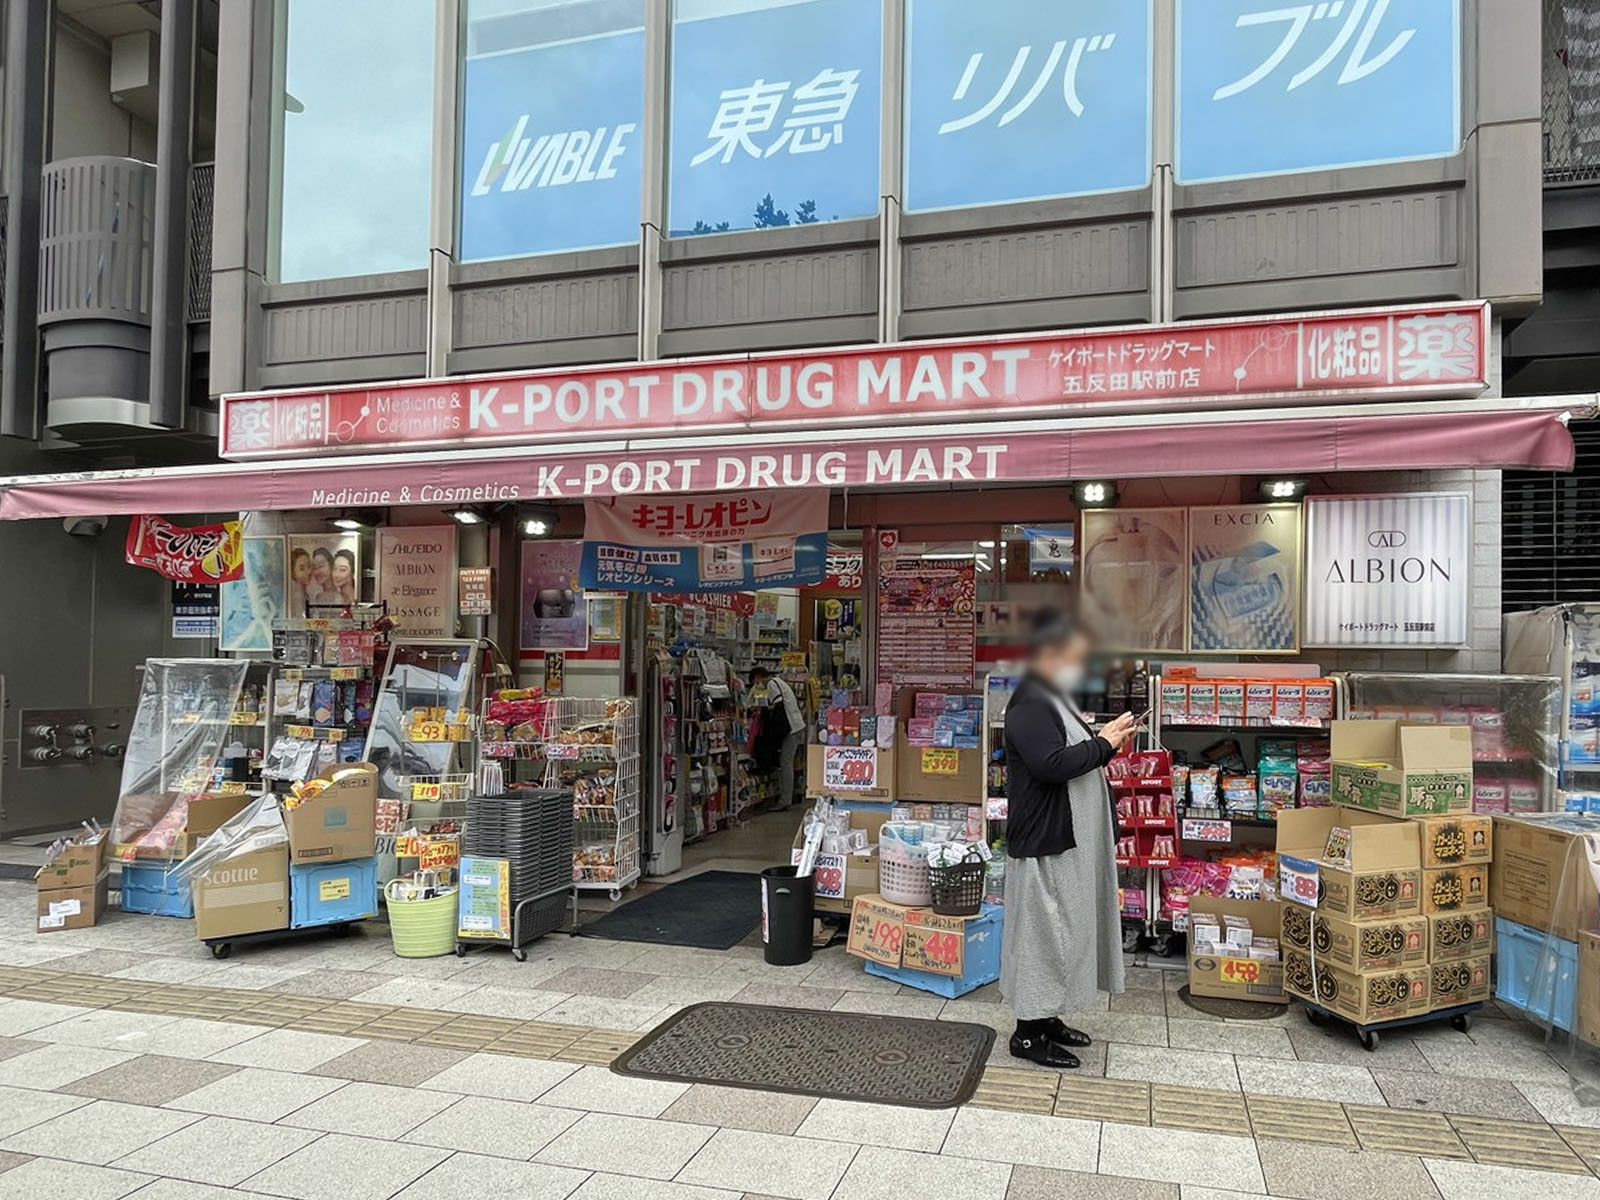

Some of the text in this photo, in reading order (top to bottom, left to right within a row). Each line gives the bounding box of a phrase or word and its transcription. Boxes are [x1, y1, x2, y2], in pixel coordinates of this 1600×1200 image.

[692, 67, 862, 166] 東急
[938, 33, 1117, 135] リバ
[1048, 338, 1216, 369] ケイポートドラッグマート
[1308, 325, 1382, 380] 化粧品
[1398, 314, 1476, 381] 薬
[469, 347, 1031, 430] K-PORT DRUG MART
[1063, 368, 1201, 394] 五反田駅前店
[376, 393, 461, 413] Medicine &
[230, 400, 271, 448] 薬
[279, 401, 323, 442] 化粧品
[376, 413, 461, 434] Cosmetics
[538, 445, 1008, 498] K-PORT DRUG MART
[311, 481, 520, 507] Medicine & Cosmetics
[1214, 512, 1275, 526] EXCIA
[389, 544, 442, 555] SHISEIDO
[395, 564, 436, 576] ALBION
[597, 571, 676, 587] レオピンシリーズ
[1325, 558, 1452, 584] ALBION
[422, 725, 440, 739] 93
[843, 759, 875, 781] 980
[932, 758, 958, 770] 398
[421, 786, 439, 797] 118
[203, 866, 258, 886] Scottie
[1295, 876, 1317, 899] 88
[872, 920, 901, 953] 198
[924, 931, 959, 964] 48
[1224, 959, 1259, 981] 458
